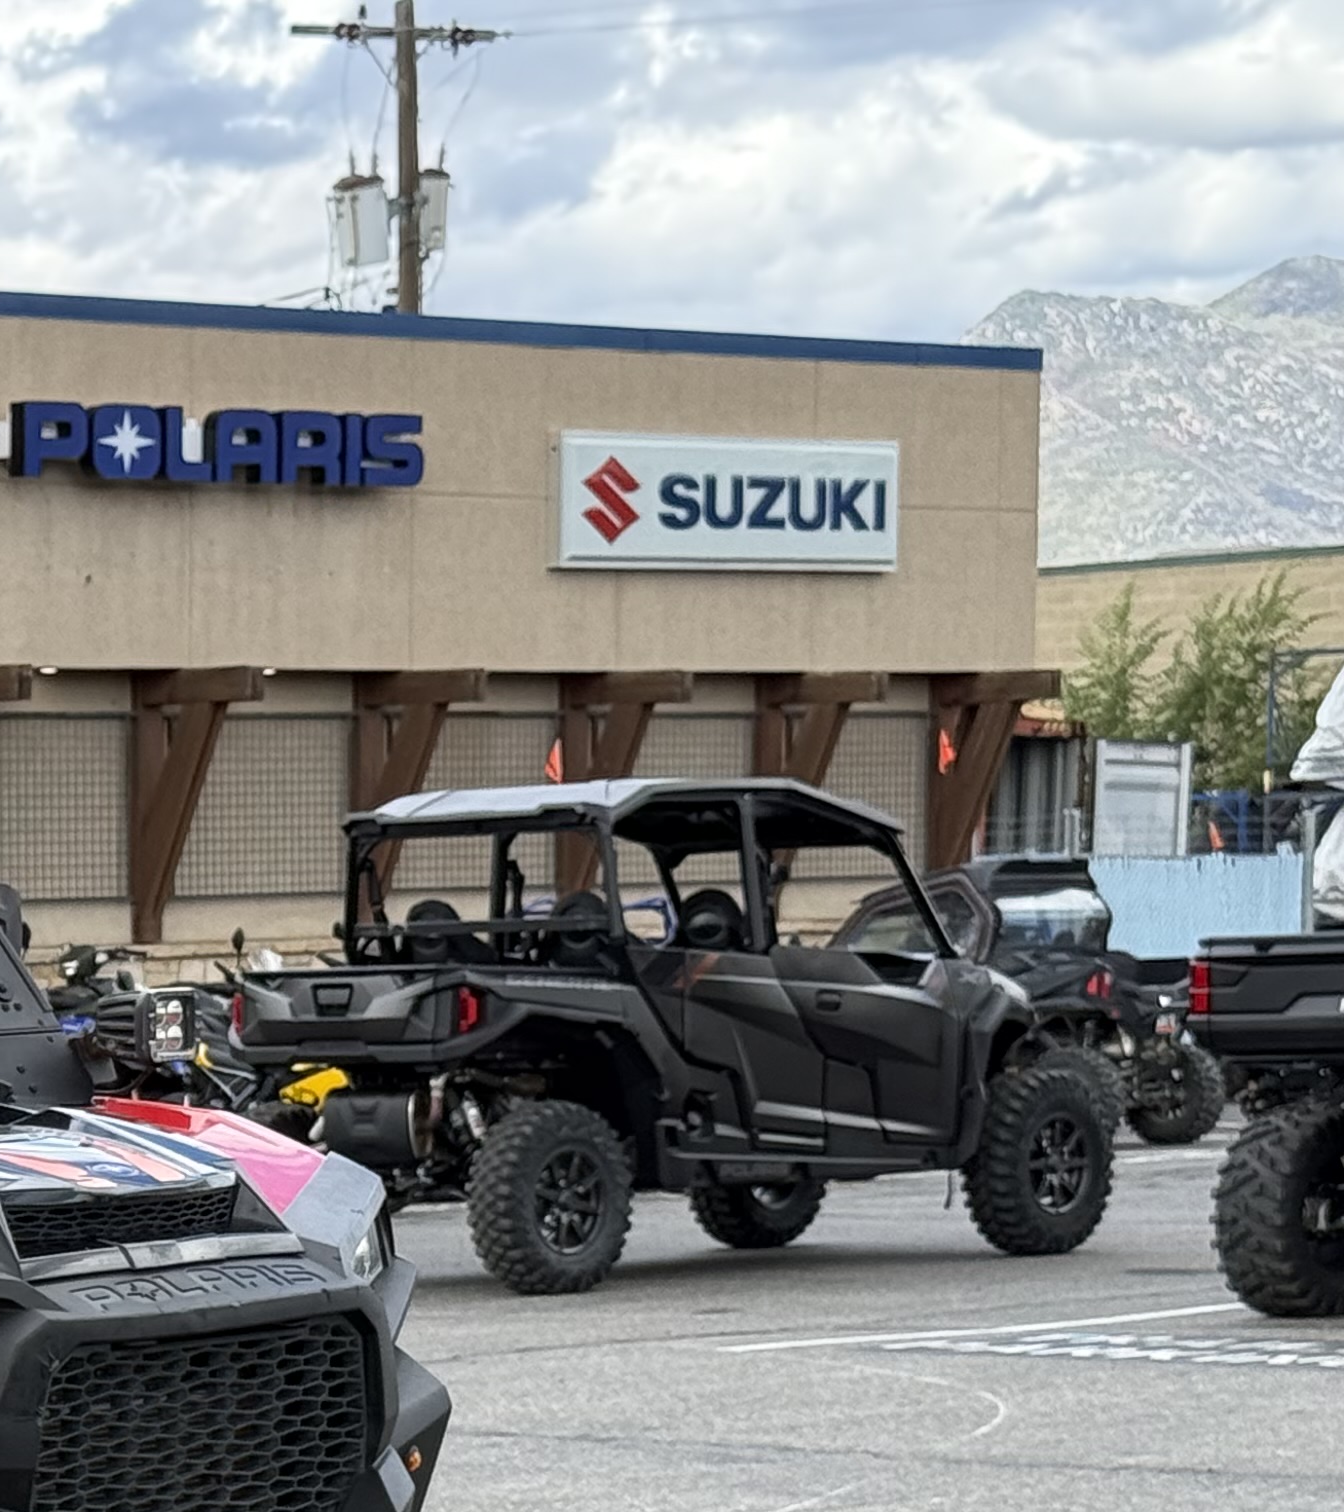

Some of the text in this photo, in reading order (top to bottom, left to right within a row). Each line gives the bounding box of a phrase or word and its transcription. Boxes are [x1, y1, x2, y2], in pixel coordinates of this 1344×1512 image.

[13, 402, 423, 487] POLARIS
[658, 473, 886, 532] SUZUKI
[69, 1262, 328, 1312] POLARIS
